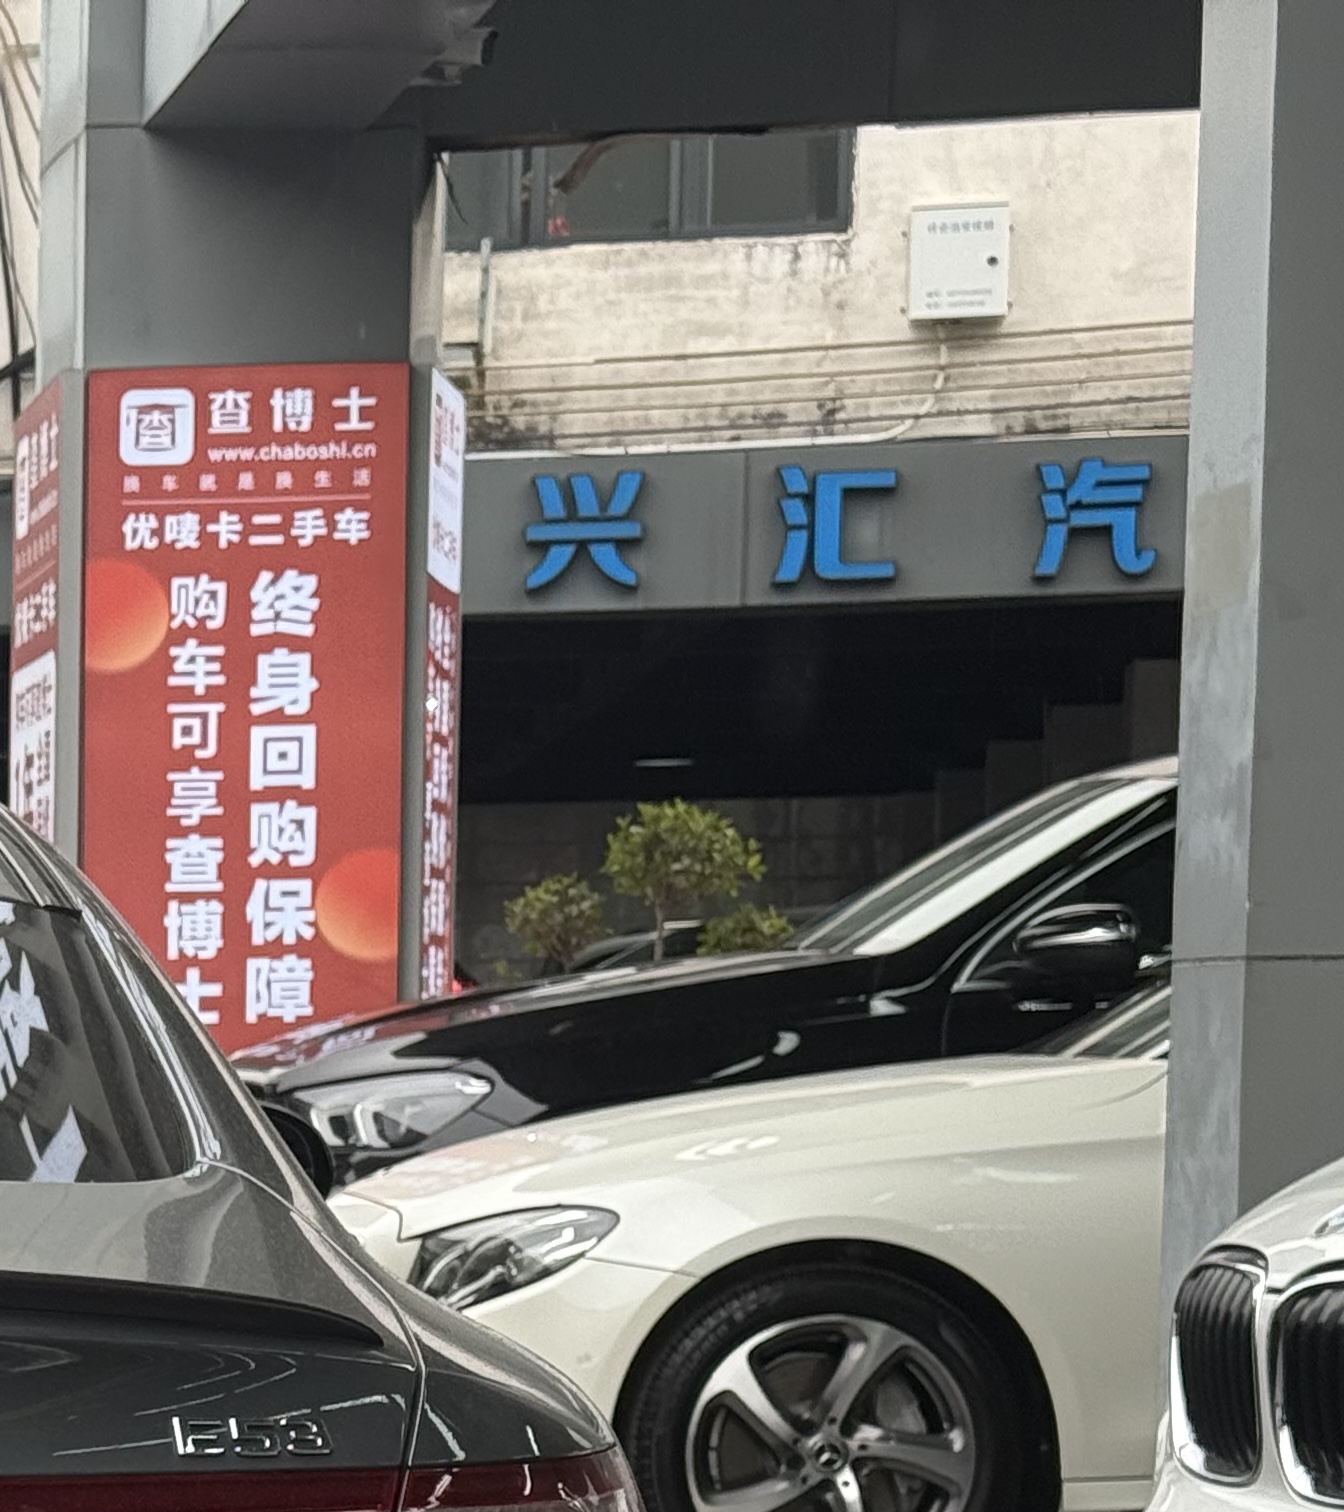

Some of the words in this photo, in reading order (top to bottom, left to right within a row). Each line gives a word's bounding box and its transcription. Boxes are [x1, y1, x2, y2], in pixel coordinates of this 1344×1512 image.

[207, 385, 378, 435] 查博士
[207, 439, 377, 464] www.chaboshi.cn
[121, 507, 372, 552] 优唛卡二手车
[525, 457, 1157, 592] 兴汇汽
[164, 573, 228, 1026] 购车可享查博士
[245, 568, 321, 1026] 终身回购保障
